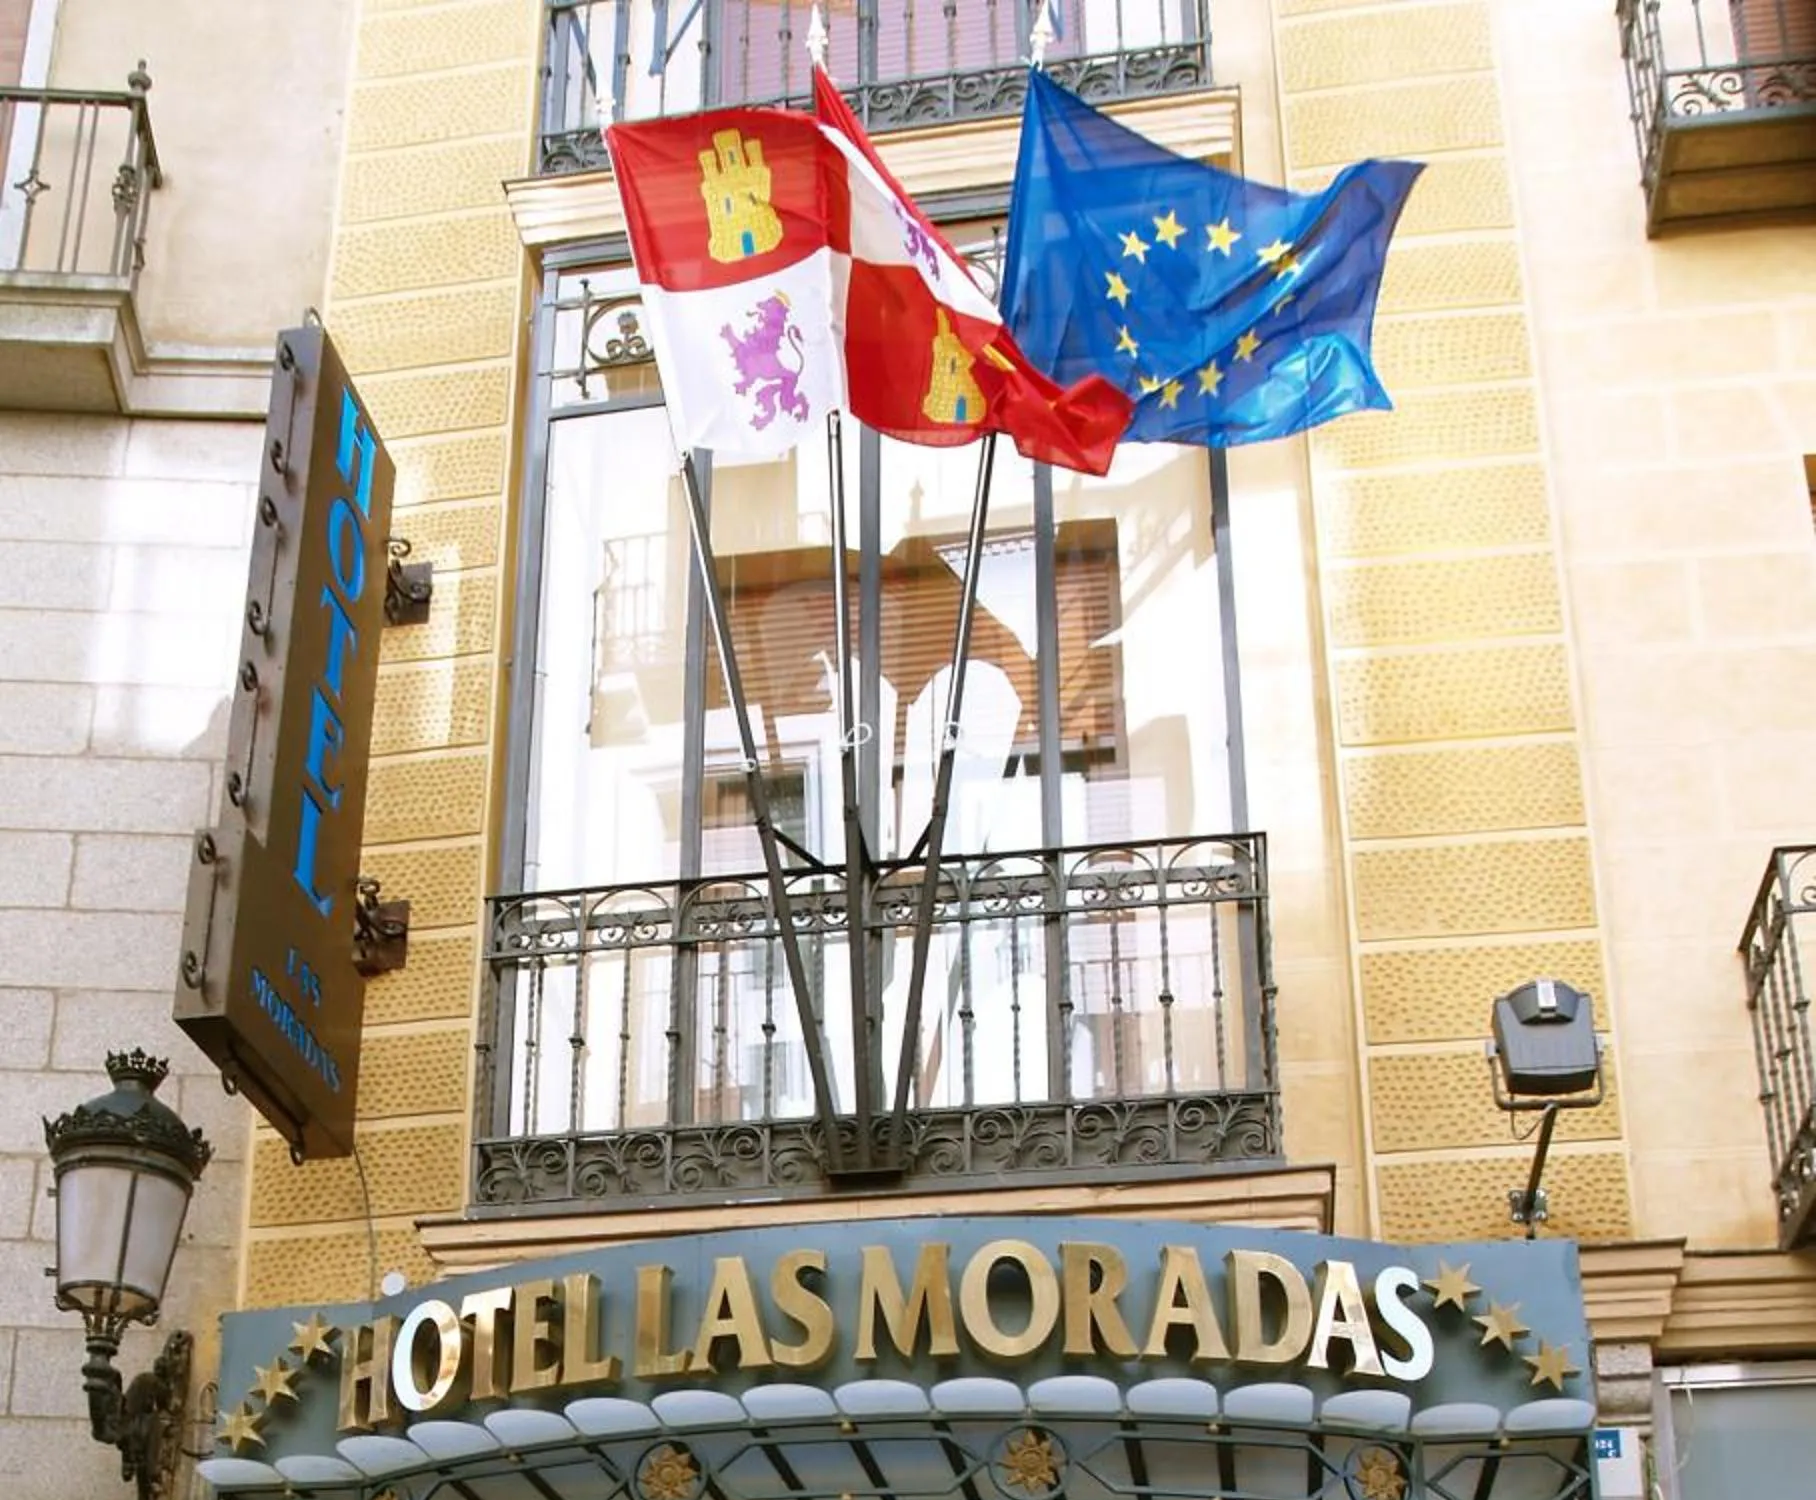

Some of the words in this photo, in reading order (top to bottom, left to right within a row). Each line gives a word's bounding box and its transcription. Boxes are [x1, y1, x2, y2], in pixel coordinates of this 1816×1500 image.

[294, 386, 377, 917] HOTEL
[251, 966, 341, 1094] MORADAS
[287, 946, 322, 1008] LAS
[337, 1271, 622, 1433] HOTEL
[634, 1249, 835, 1378] LAS
[853, 1239, 1434, 1382] MORADAS
